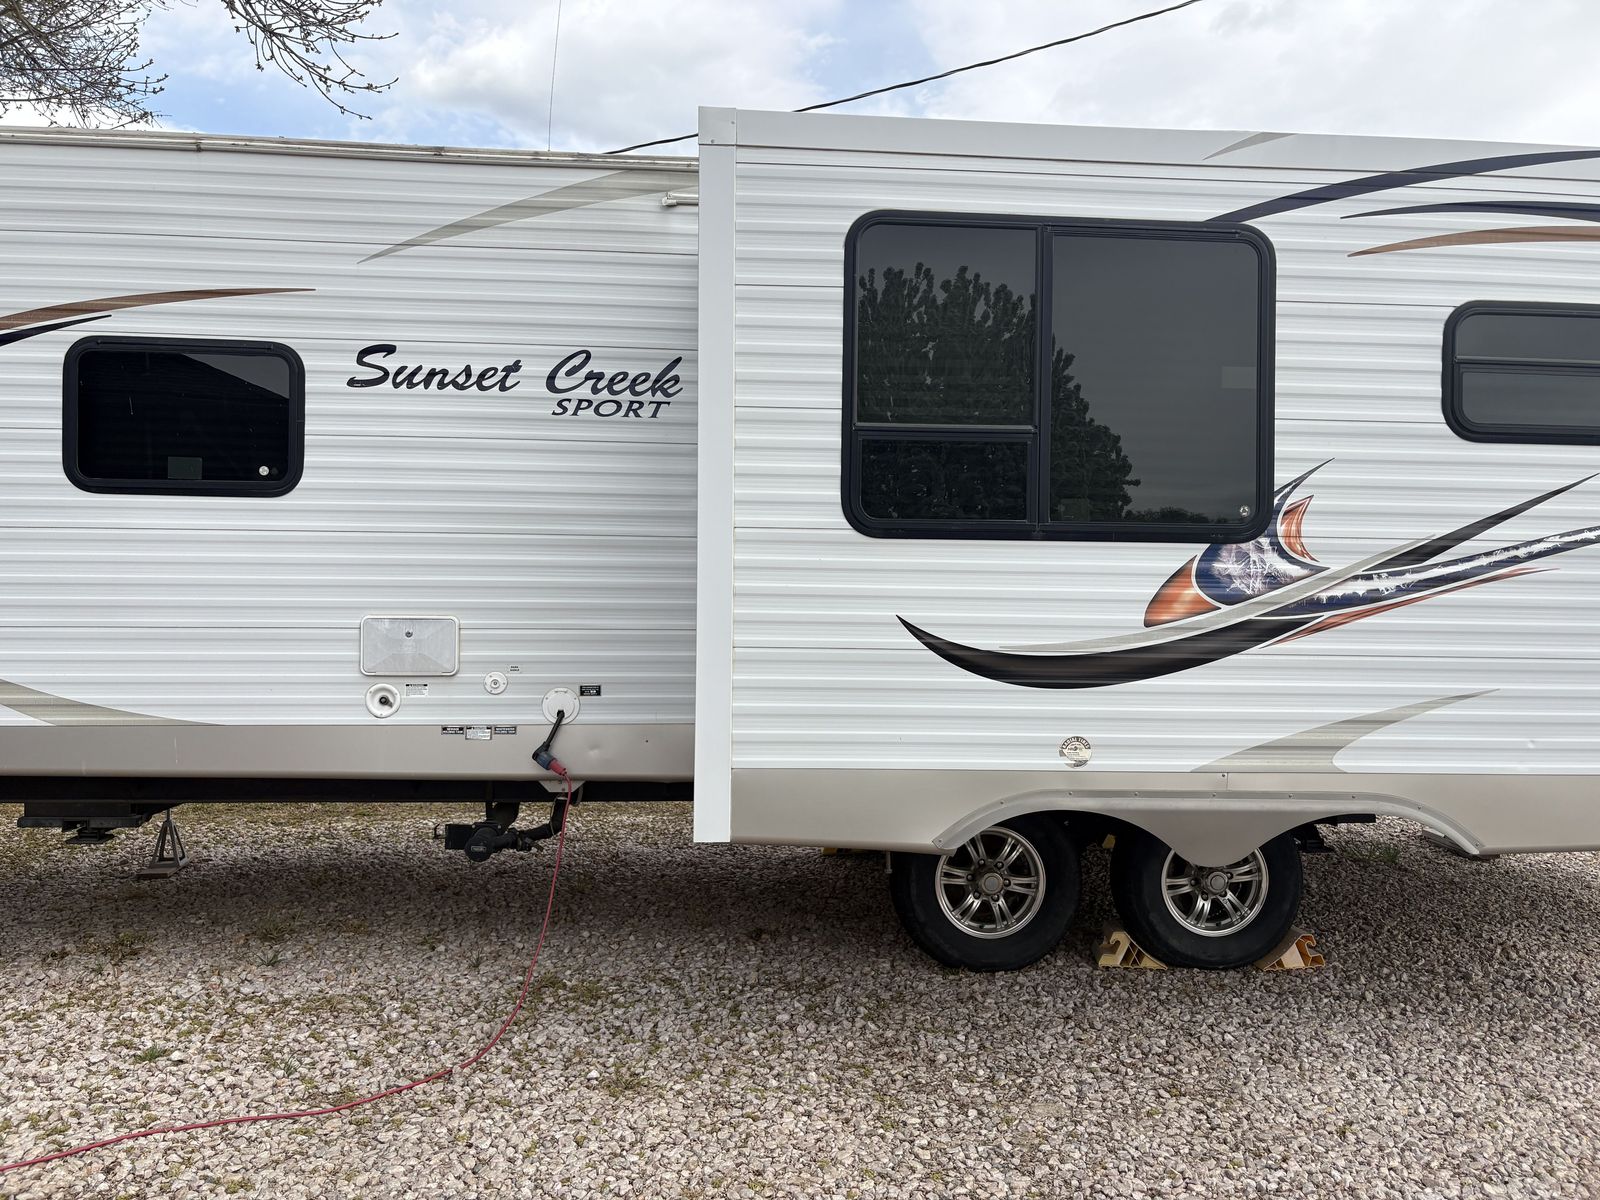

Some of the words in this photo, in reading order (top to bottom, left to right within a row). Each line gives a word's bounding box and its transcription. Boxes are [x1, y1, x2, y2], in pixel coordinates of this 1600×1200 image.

[346, 344, 522, 392] Sunset
[546, 350, 683, 398] Creek
[551, 398, 670, 418] SPORT
